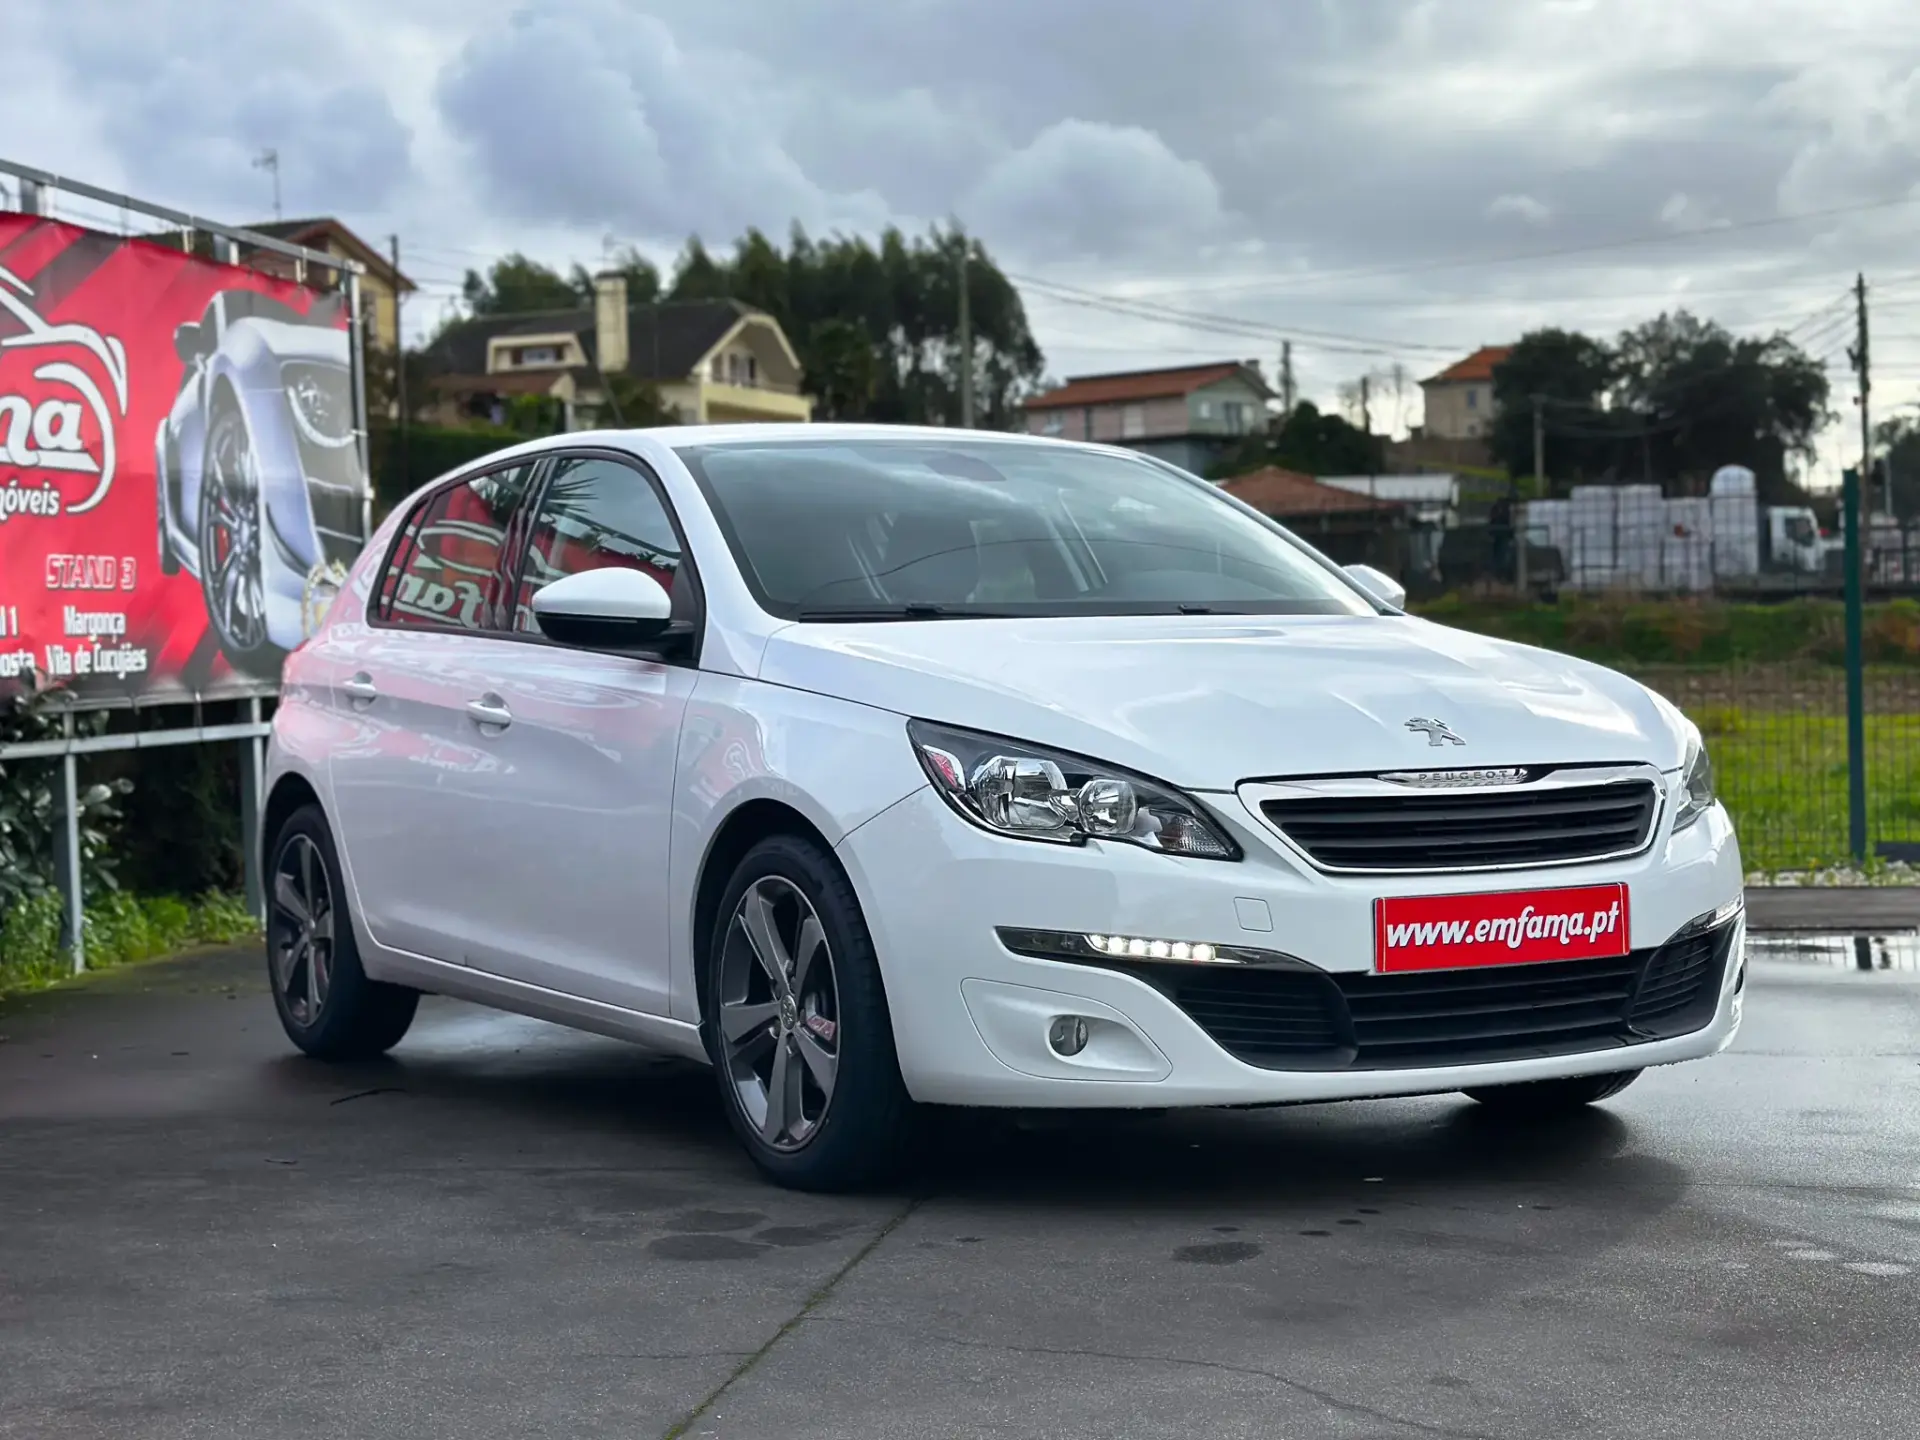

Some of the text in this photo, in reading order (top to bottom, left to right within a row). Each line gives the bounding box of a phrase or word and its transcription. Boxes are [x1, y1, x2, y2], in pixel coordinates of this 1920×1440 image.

[46, 554, 137, 591] STAND 3
[45, 645, 72, 674] Vila
[74, 644, 91, 674] de
[1418, 770, 1508, 782] PEUGEOT
[1387, 900, 1620, 949] www.emfama.pt
